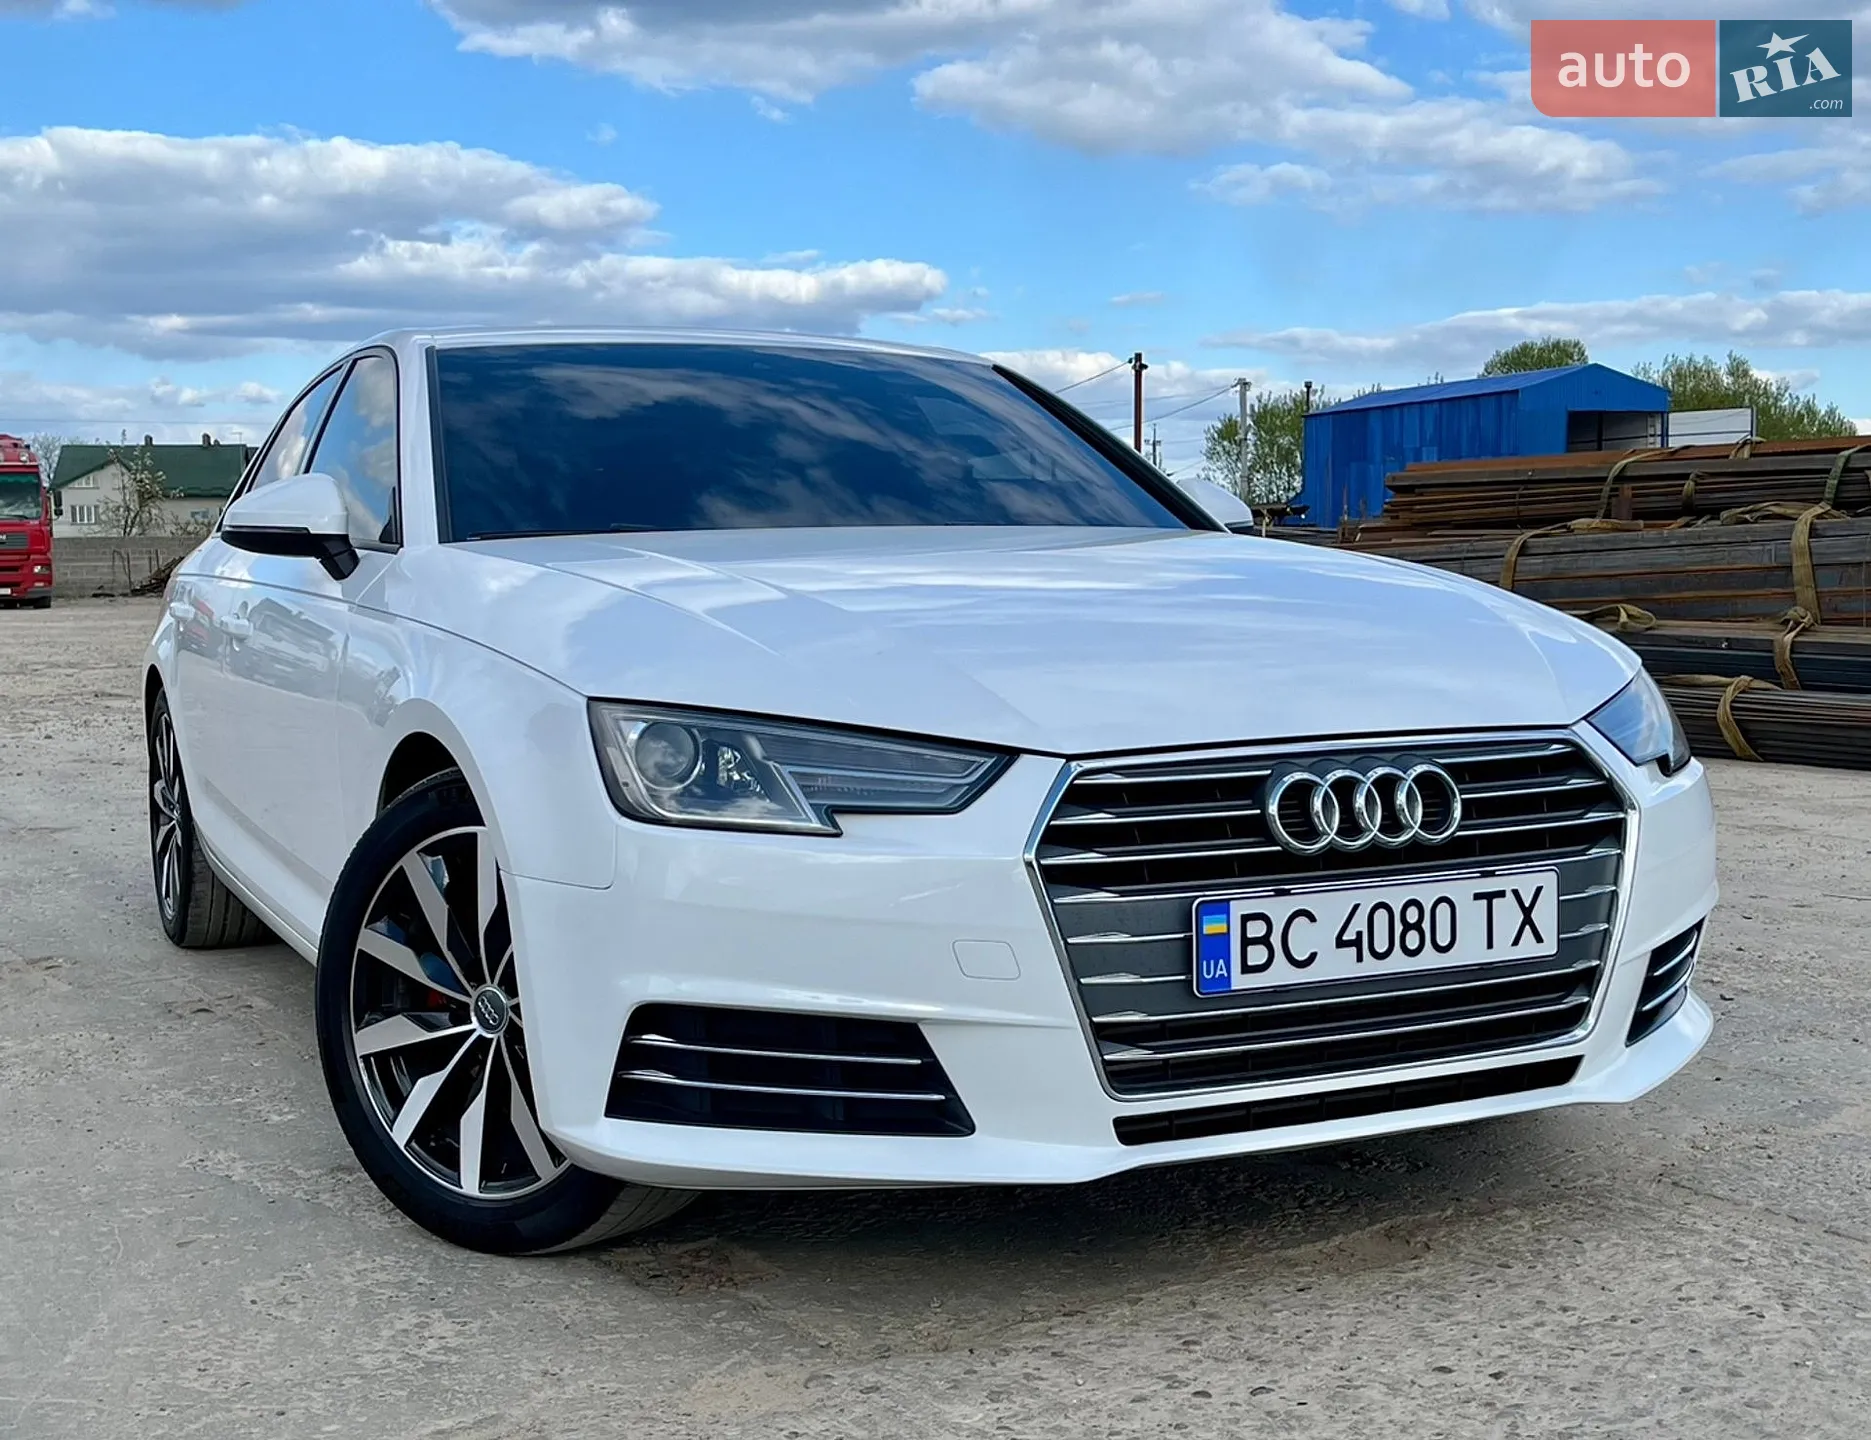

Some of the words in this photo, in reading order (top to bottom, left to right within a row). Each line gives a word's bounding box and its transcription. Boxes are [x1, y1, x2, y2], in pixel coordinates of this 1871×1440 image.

[1240, 908, 1318, 975] BC
[1335, 895, 1457, 963] 4080
[1472, 885, 1544, 950] TX
[1202, 960, 1228, 979] UA
